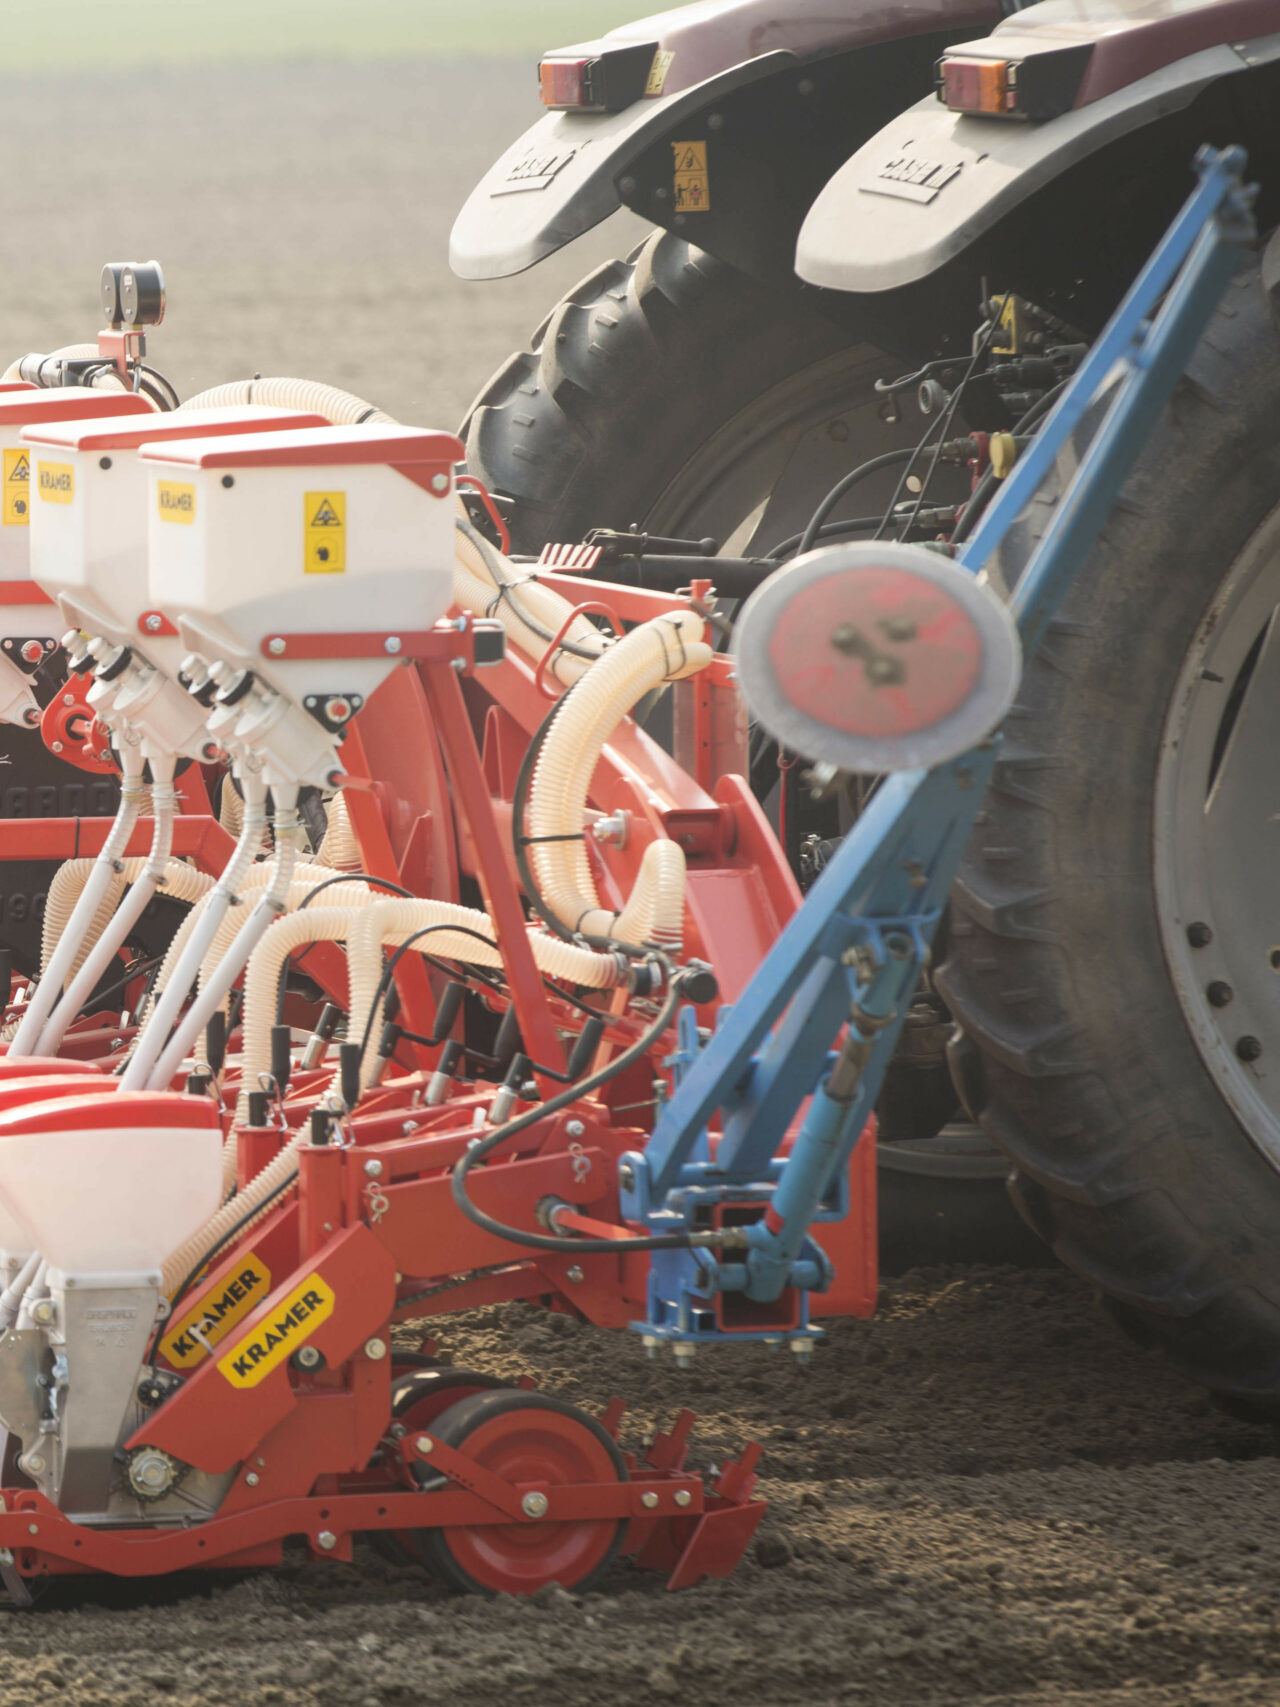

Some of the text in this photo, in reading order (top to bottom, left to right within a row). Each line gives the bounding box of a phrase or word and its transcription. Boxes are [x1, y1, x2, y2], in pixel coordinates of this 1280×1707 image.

[40, 470, 72, 491] KRAMER
[160, 490, 193, 512] KRAMER
[232, 1290, 325, 1378] KRAMER
